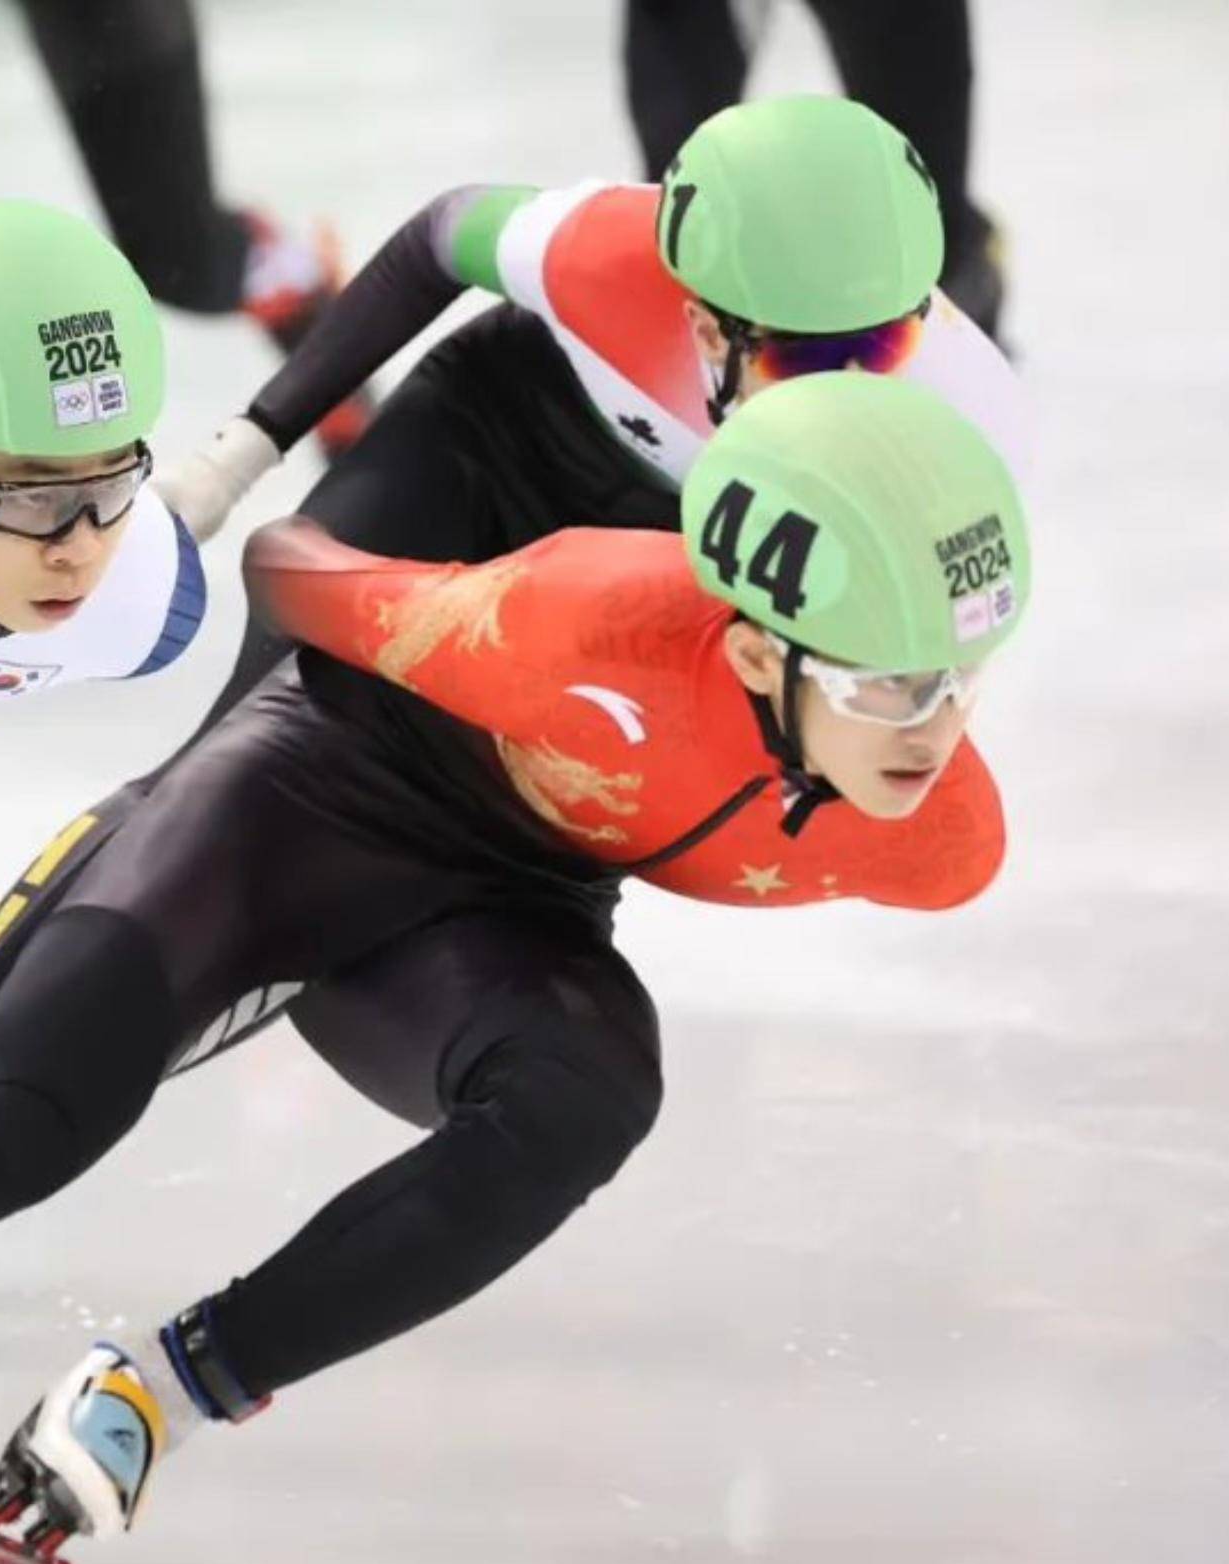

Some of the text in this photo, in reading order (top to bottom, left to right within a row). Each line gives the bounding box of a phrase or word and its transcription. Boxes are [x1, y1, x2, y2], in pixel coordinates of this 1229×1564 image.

[37, 309, 115, 346] GANGWON
[44, 334, 122, 382] 2024
[700, 478, 820, 621] 44
[944, 538, 1012, 600] 2024
